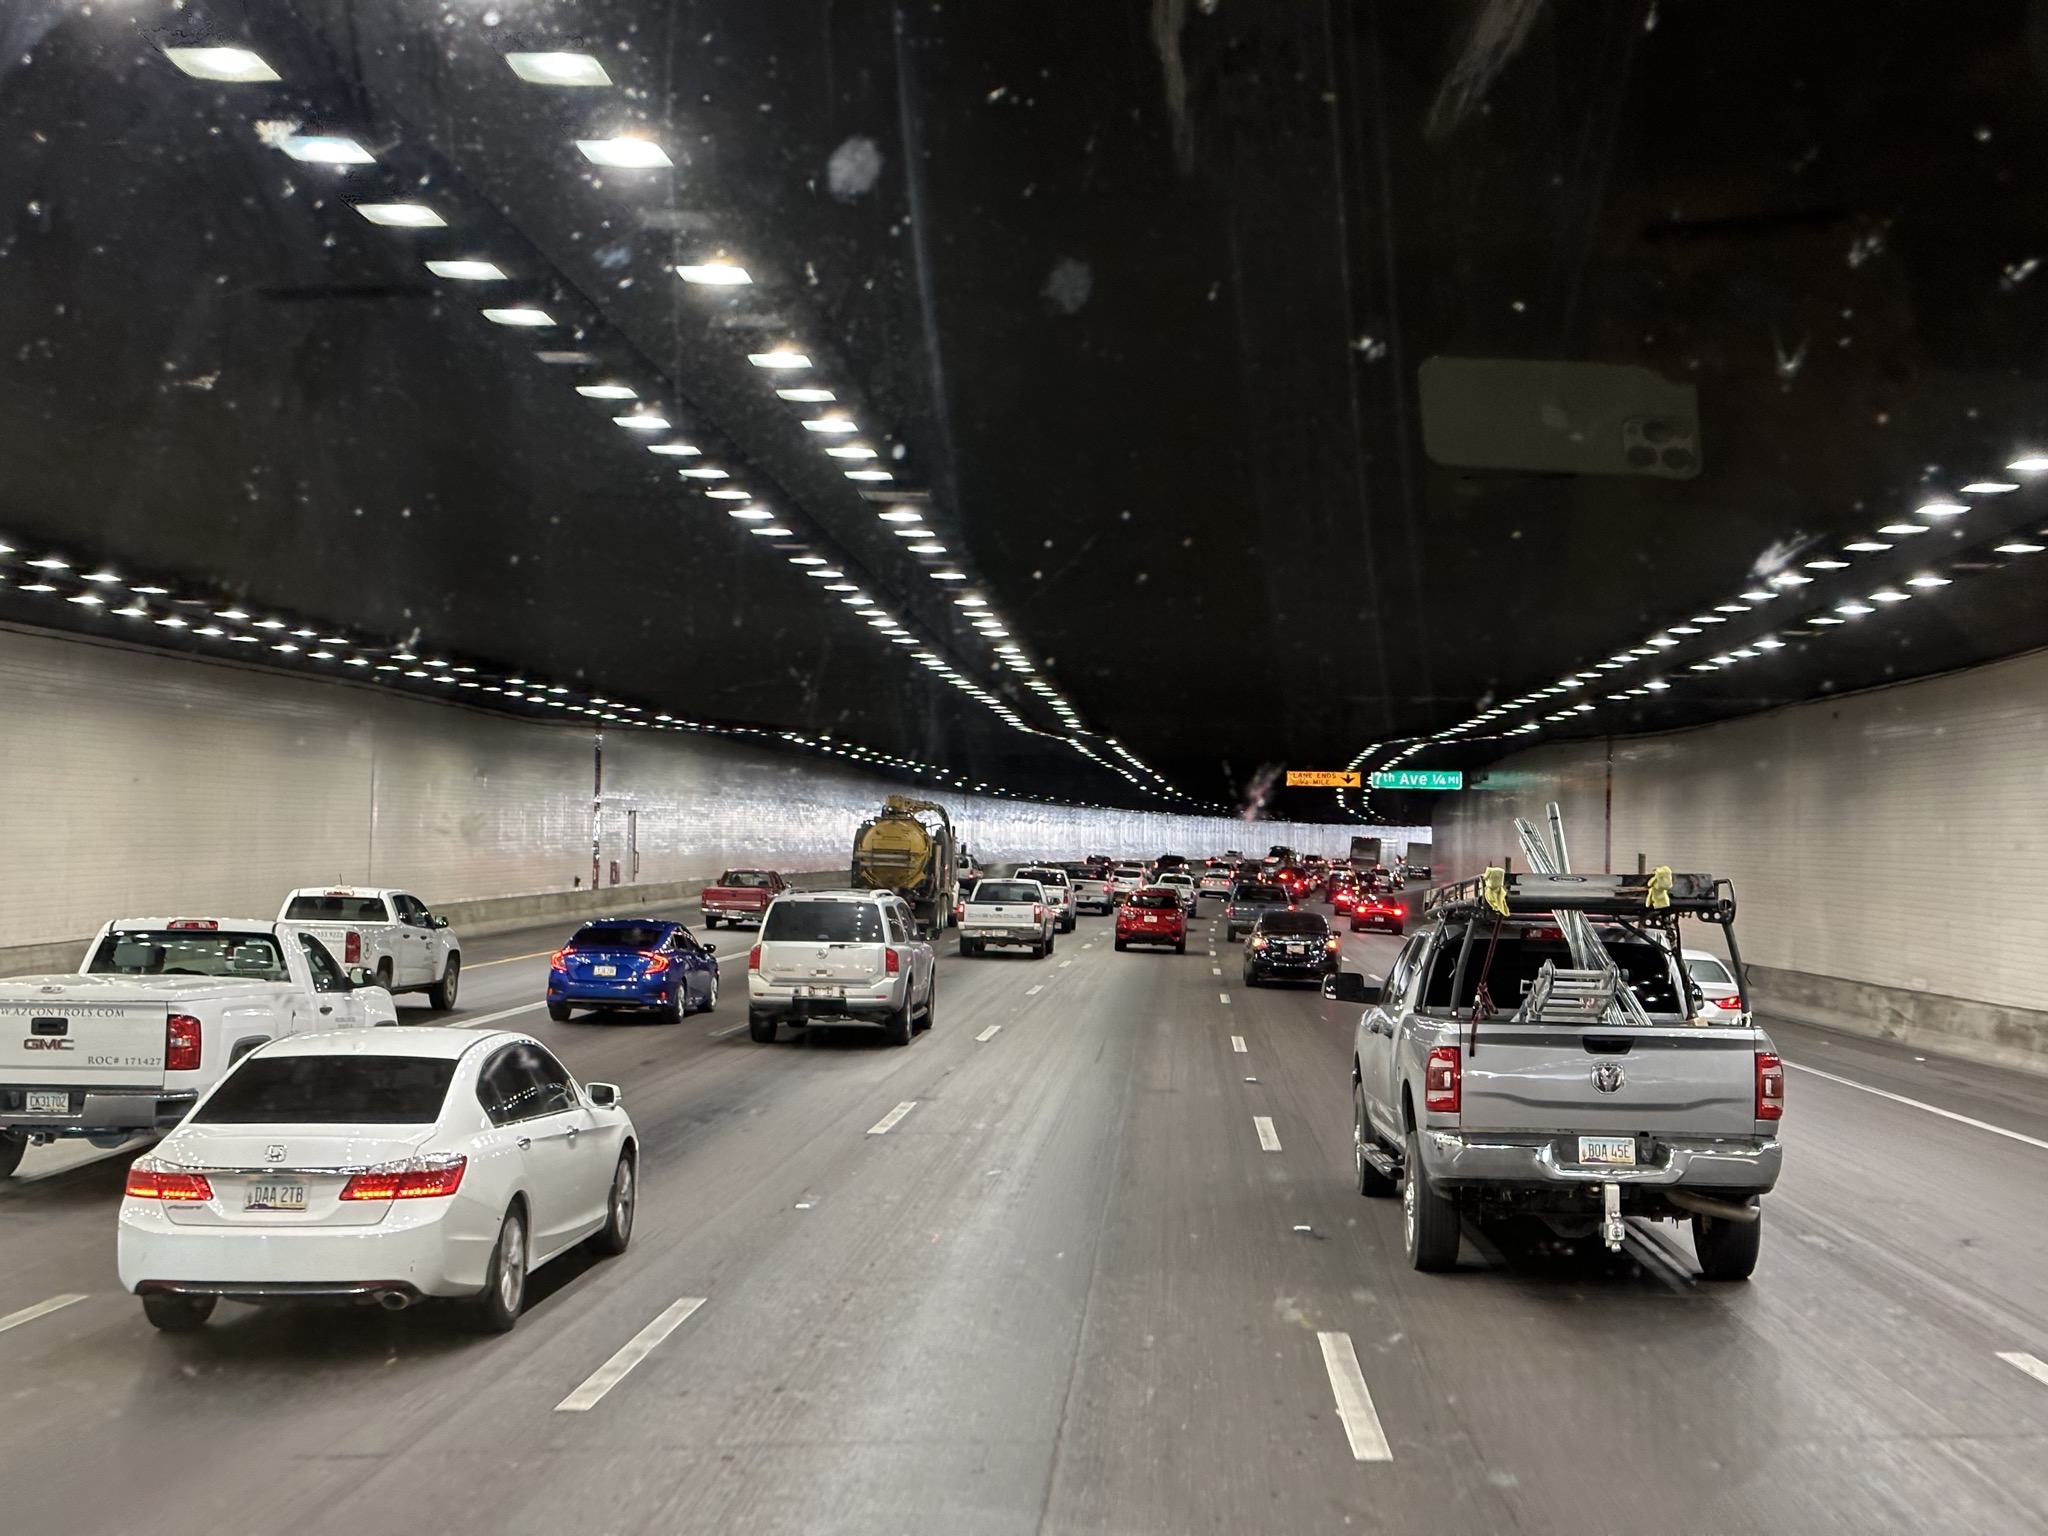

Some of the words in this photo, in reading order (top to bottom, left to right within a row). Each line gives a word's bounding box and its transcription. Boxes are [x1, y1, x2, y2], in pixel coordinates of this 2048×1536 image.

[1374, 772, 1395, 785] 7th
[1400, 772, 1428, 785] Ave
[1448, 776, 1459, 784] MI
[24, 1038, 74, 1050] GMC
[88, 1056, 119, 1065] ROC#
[125, 1057, 162, 1066] 171427
[1612, 1144, 1631, 1158] 45E
[254, 1186, 277, 1203] DAA
[281, 1186, 304, 1203] 2TB
